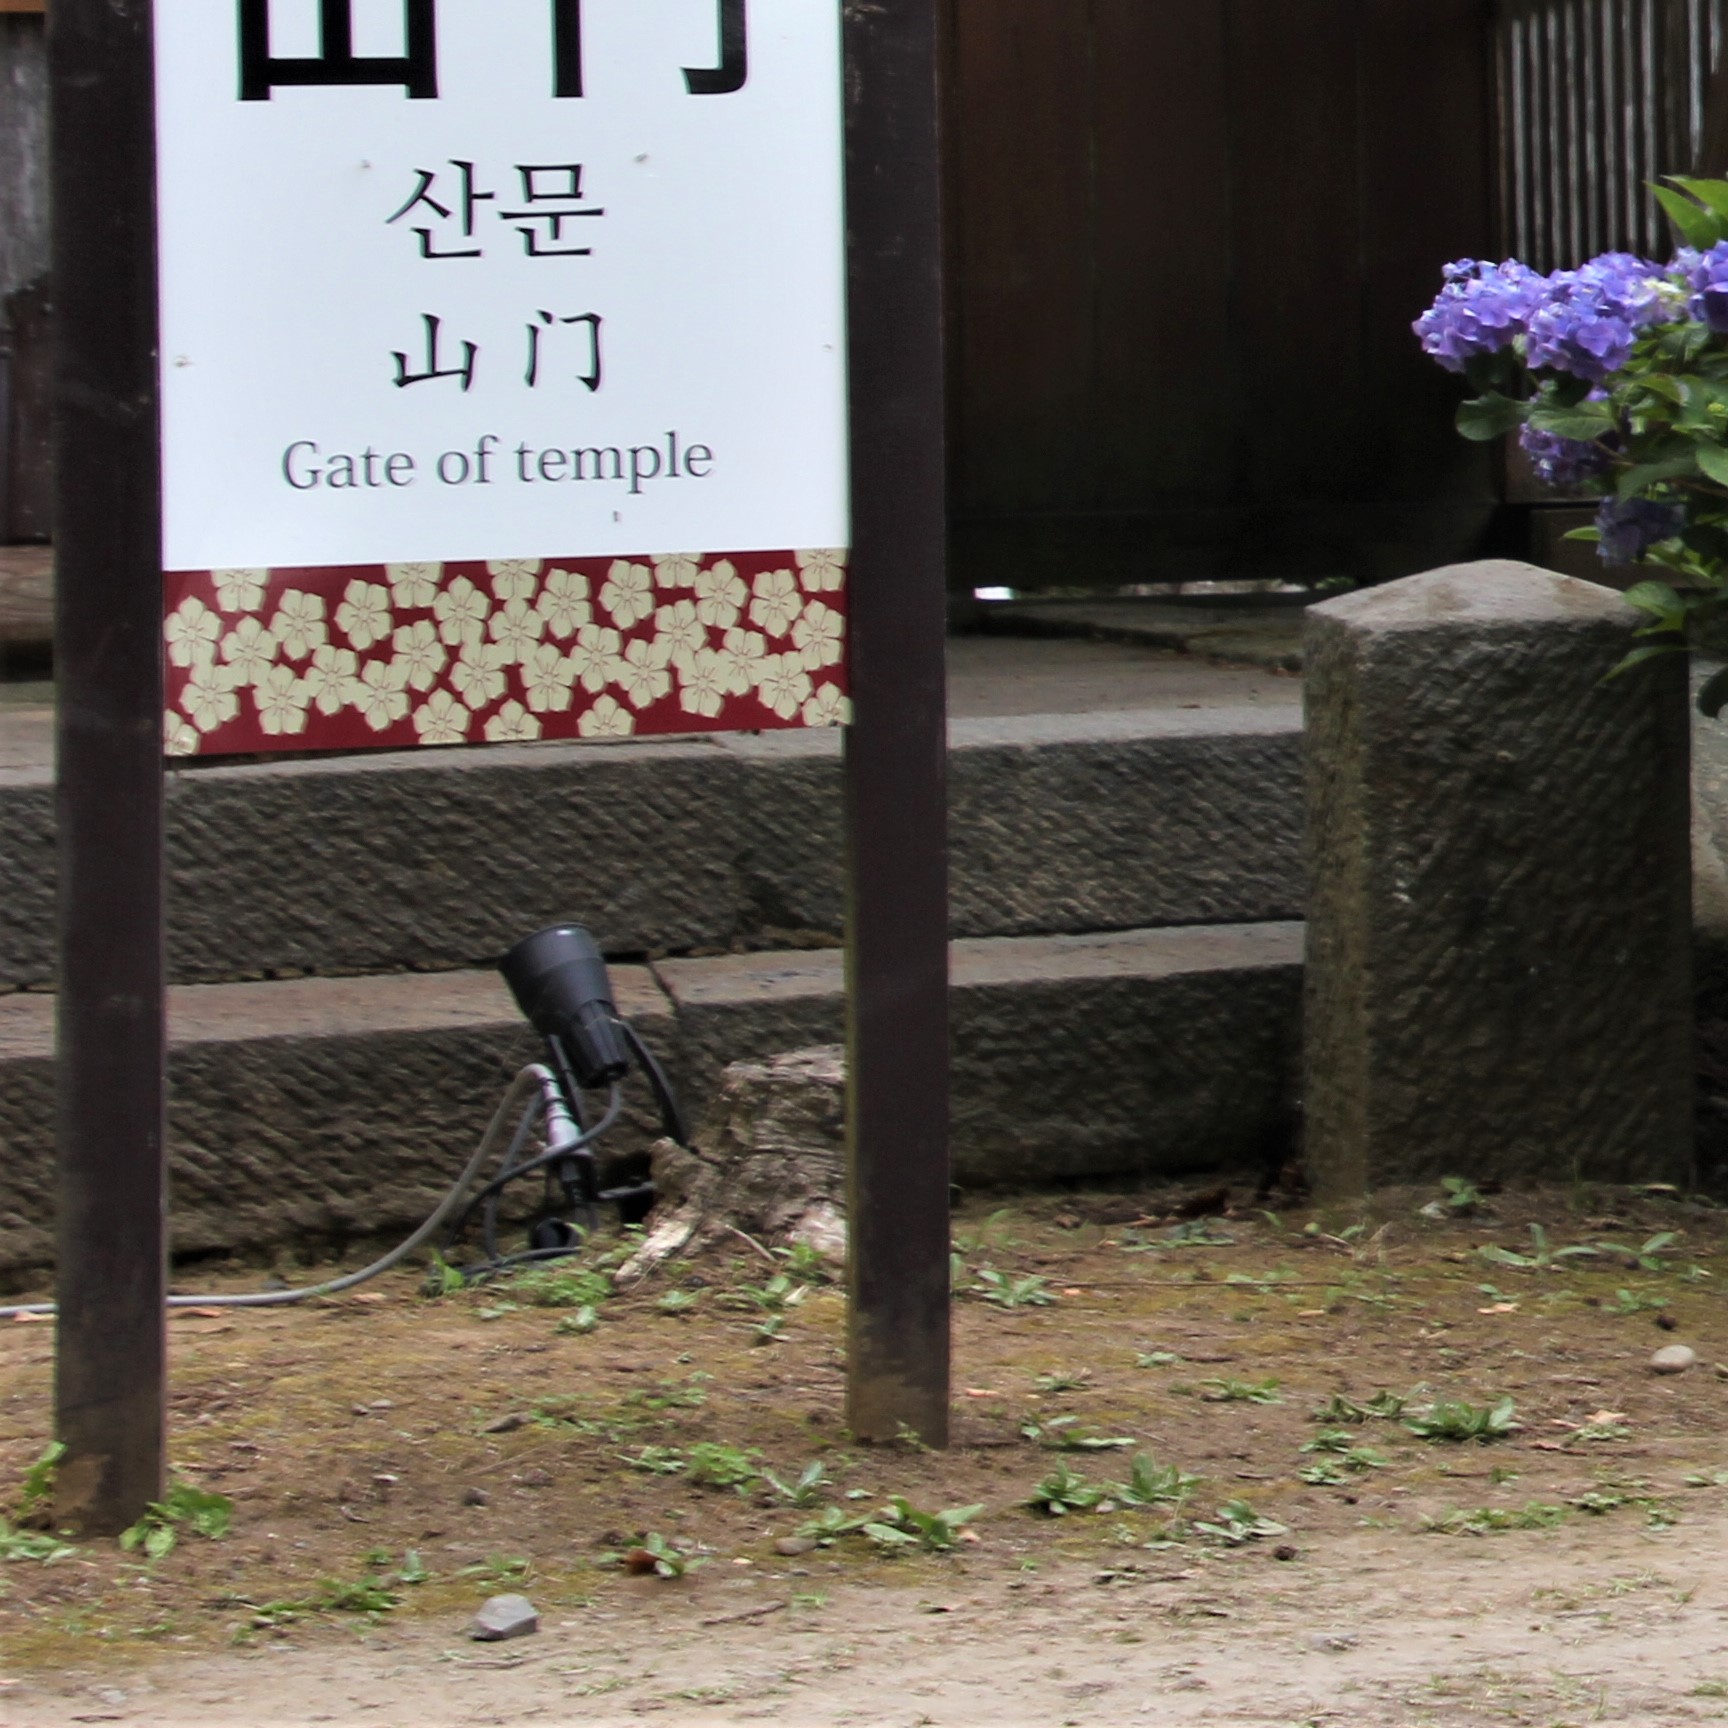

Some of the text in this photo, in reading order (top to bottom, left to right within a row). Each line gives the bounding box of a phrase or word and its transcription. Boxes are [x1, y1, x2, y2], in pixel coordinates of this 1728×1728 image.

[385, 159, 606, 261] 산문
[281, 429, 714, 495] Gate of temple
